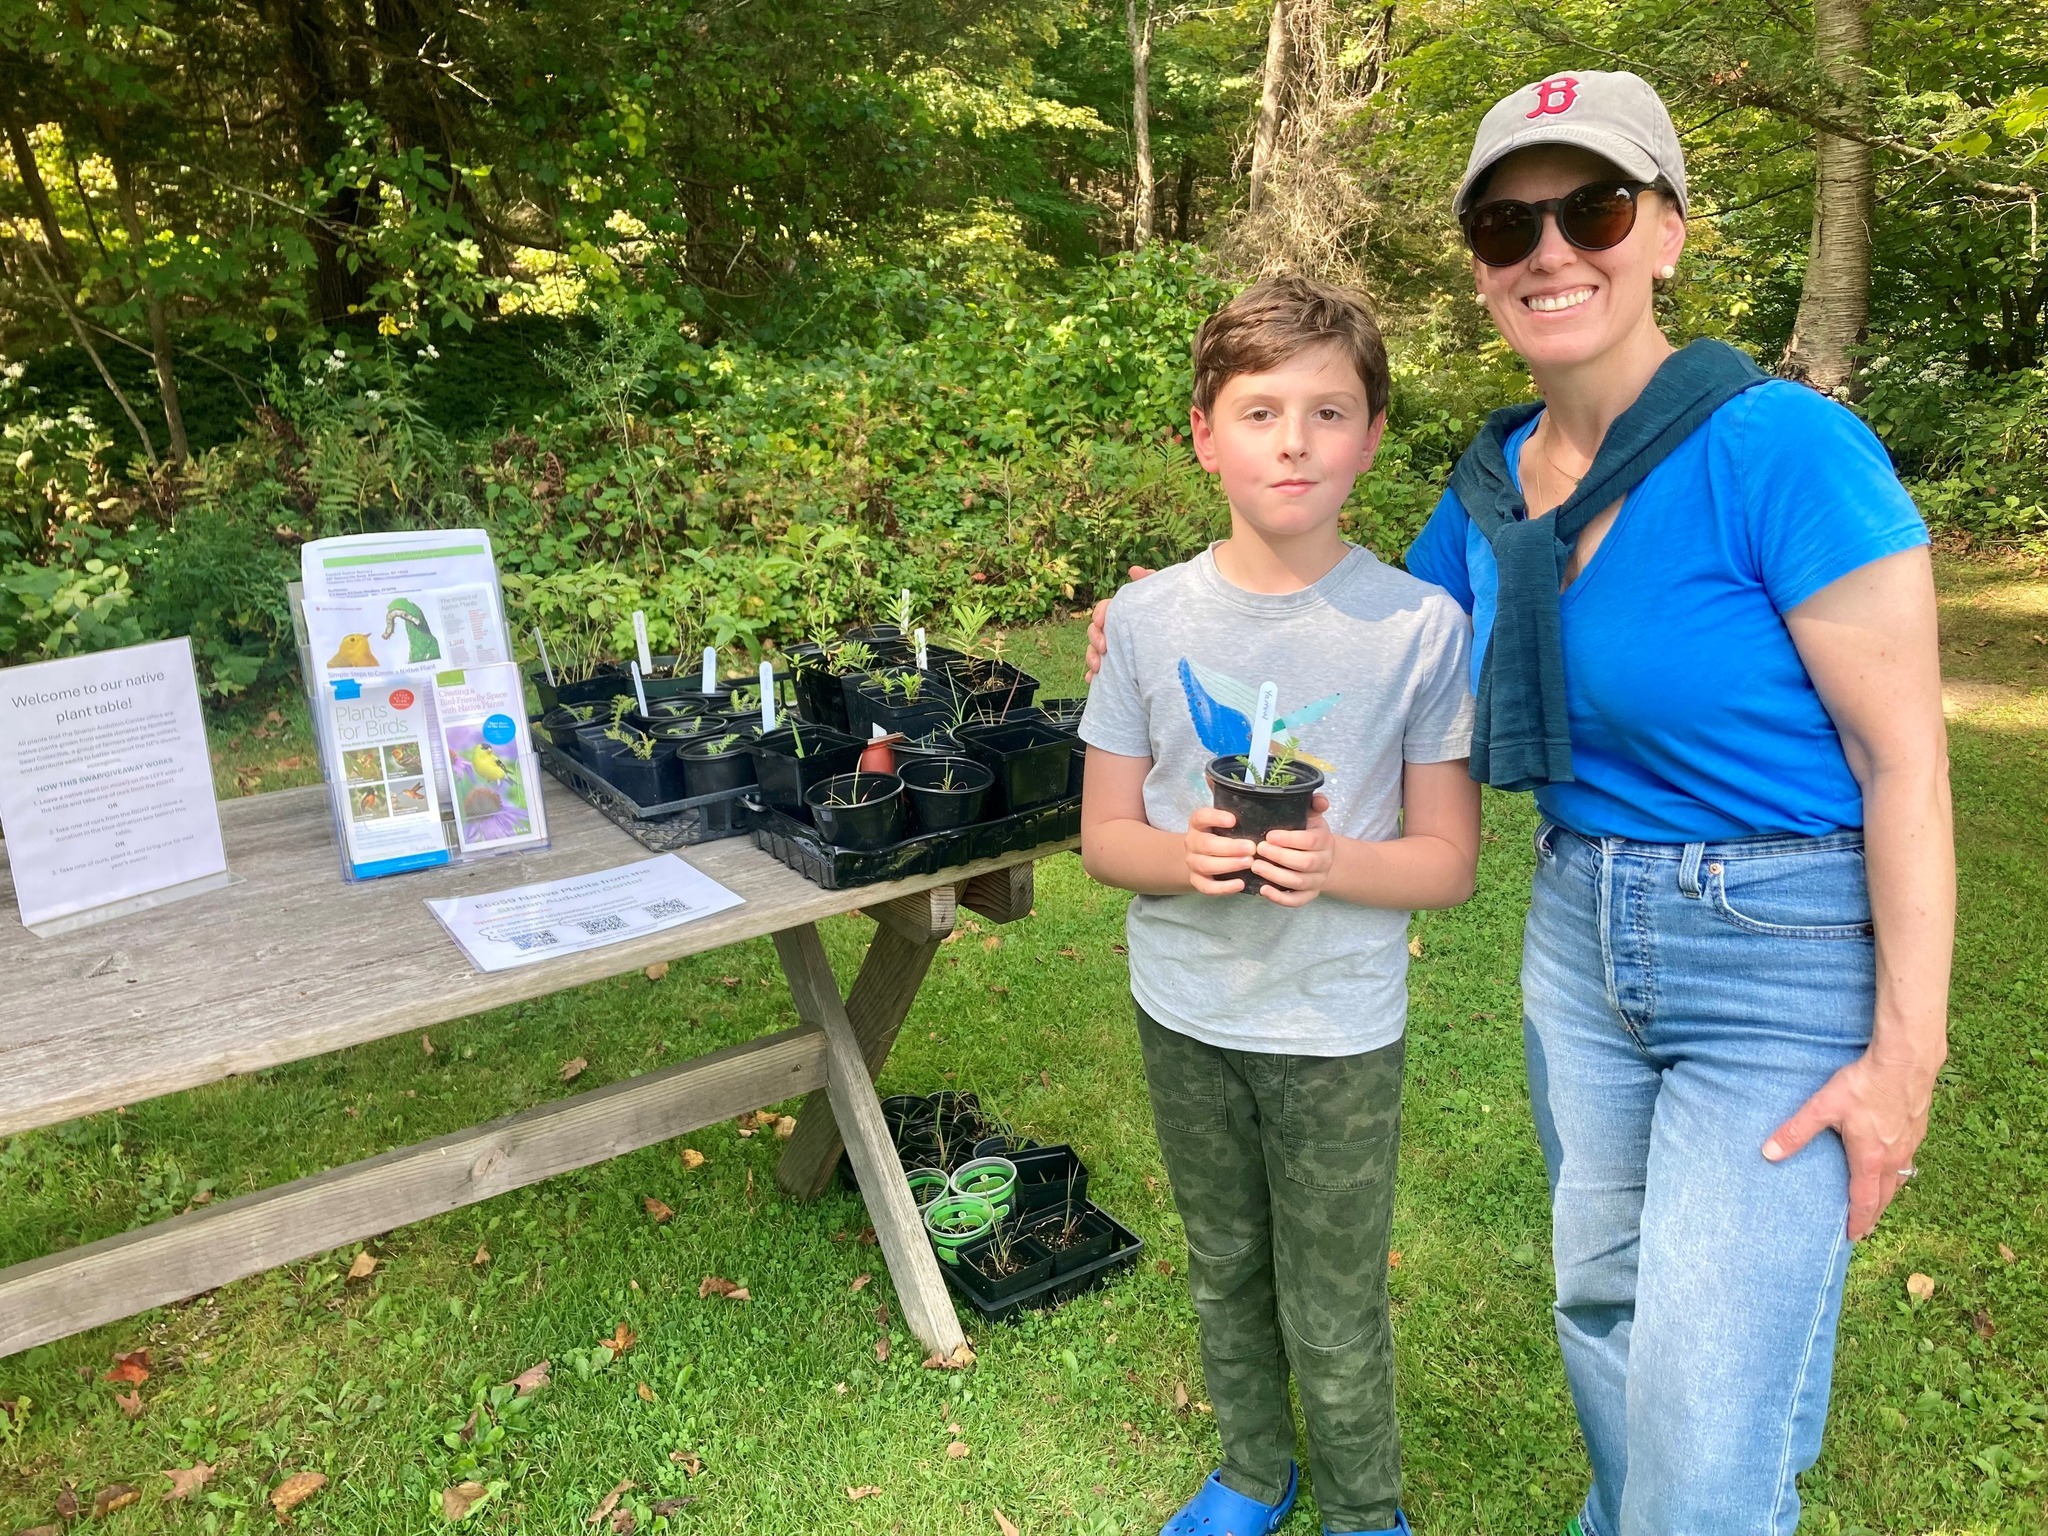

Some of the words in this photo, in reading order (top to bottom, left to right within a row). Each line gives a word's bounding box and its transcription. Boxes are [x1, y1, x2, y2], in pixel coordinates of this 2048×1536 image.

[1525, 77, 1581, 119] B
[11, 686, 81, 709] Welcome
[84, 680, 97, 695] to
[100, 678, 122, 692] our
[126, 671, 165, 688] native
[439, 688, 469, 698] Creating
[486, 692, 508, 701] Space
[1261, 690, 1273, 721] Yarrow
[56, 706, 92, 725] plant
[94, 698, 132, 715] table!
[336, 704, 388, 722] Plants
[441, 707, 456, 715] with
[460, 704, 481, 713] Native
[482, 701, 504, 710] Plants
[18, 748, 38, 756] native
[38, 744, 58, 752] plants
[60, 740, 78, 748] grown
[95, 732, 113, 740] seeds
[114, 726, 139, 736] donated
[148, 719, 176, 728] Northeast
[27, 737, 48, 746] plants
[74, 726, 96, 736] Sharon
[96, 720, 124, 731] Audubon
[338, 723, 360, 740] for
[366, 718, 408, 737] Birds
[36, 782, 58, 793] HOW
[59, 778, 78, 788] THIS
[78, 764, 144, 784] SWAP/GIVEAWAY
[145, 757, 174, 768] WORKS
[40, 797, 58, 805] Leave
[64, 790, 83, 799] native
[84, 786, 100, 795] plant
[150, 772, 164, 780] LEFT
[164, 768, 177, 776] side
[53, 803, 69, 811] table
[156, 778, 174, 786] RIGHT
[108, 802, 118, 810] OR
[131, 806, 150, 815] RIGHT
[55, 832, 83, 843] donation
[102, 824, 116, 832] blue
[116, 818, 142, 828] donation
[154, 808, 174, 818] behind
[60, 866, 74, 874] Take
[94, 857, 110, 865] ours,
[110, 852, 126, 861] plant
[146, 844, 162, 852] bring
[182, 834, 194, 842] next
[474, 898, 516, 909] Eco59
[519, 890, 559, 902] Native
[561, 882, 600, 894] Plants
[601, 874, 630, 884] from
[630, 869, 650, 878] the
[498, 900, 544, 912] Sharon
[546, 890, 601, 904] Audubon
[602, 878, 643, 891] Center
